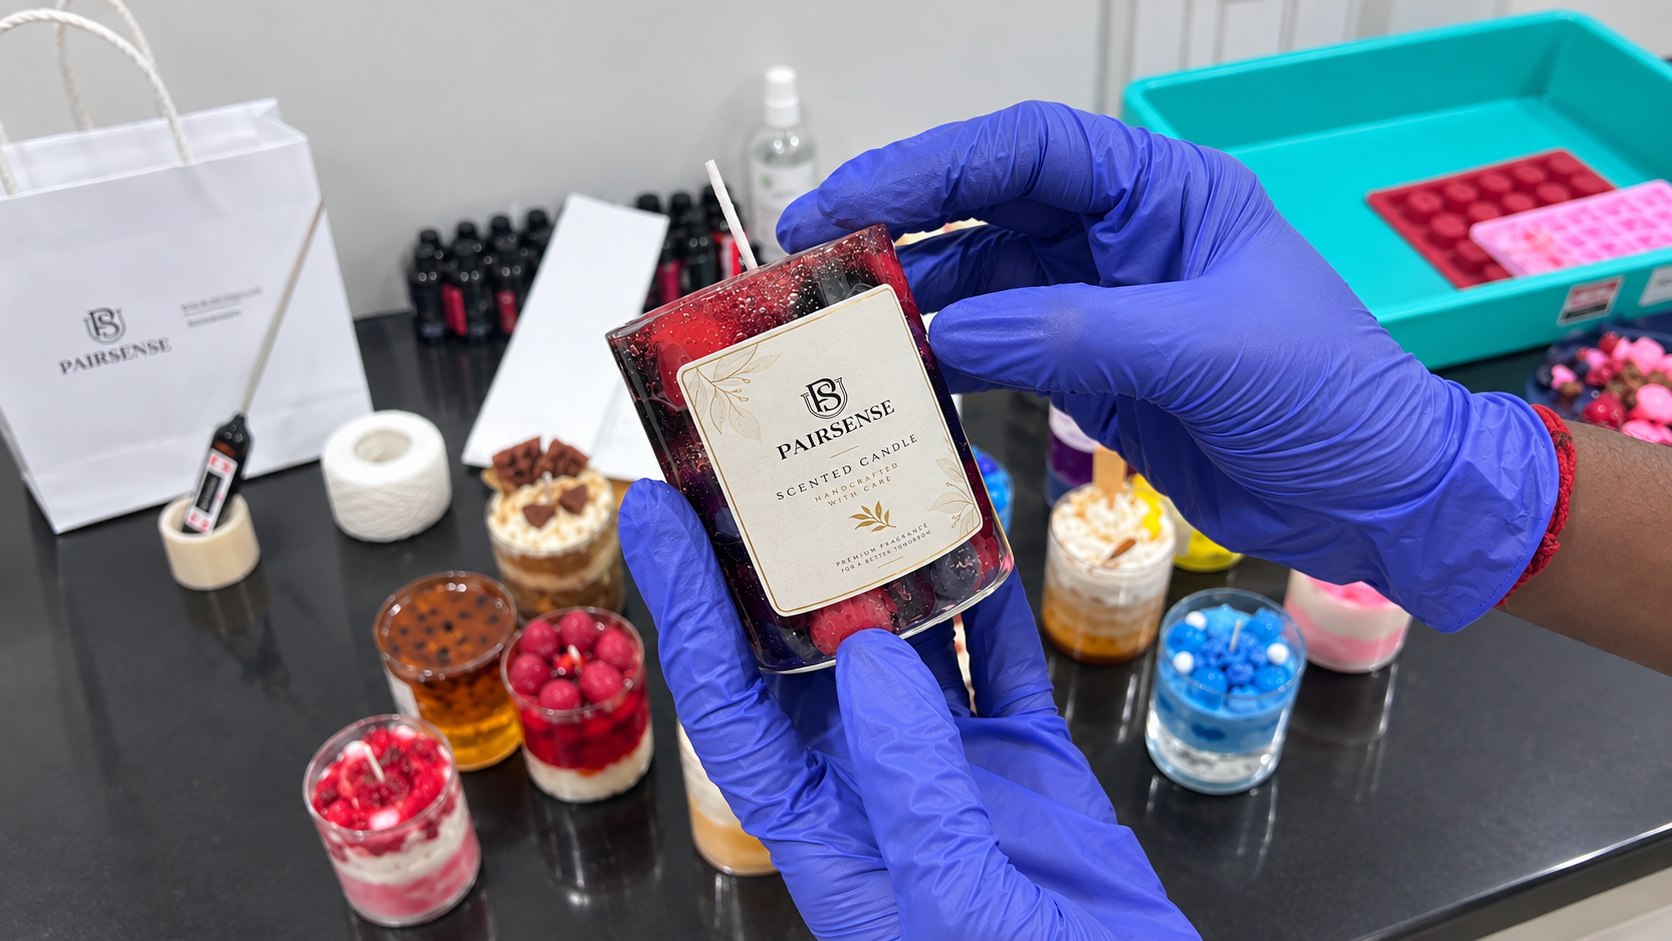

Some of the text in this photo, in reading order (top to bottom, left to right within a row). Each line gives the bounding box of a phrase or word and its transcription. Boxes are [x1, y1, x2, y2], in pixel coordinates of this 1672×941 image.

[59, 337, 172, 375] PAIRSENSE
[776, 399, 895, 460] PAIRSENSE
[776, 434, 918, 501] SCENTED CANDLE
[815, 462, 898, 502] HANDCRAFTED
[828, 476, 892, 507] WITH CARE
